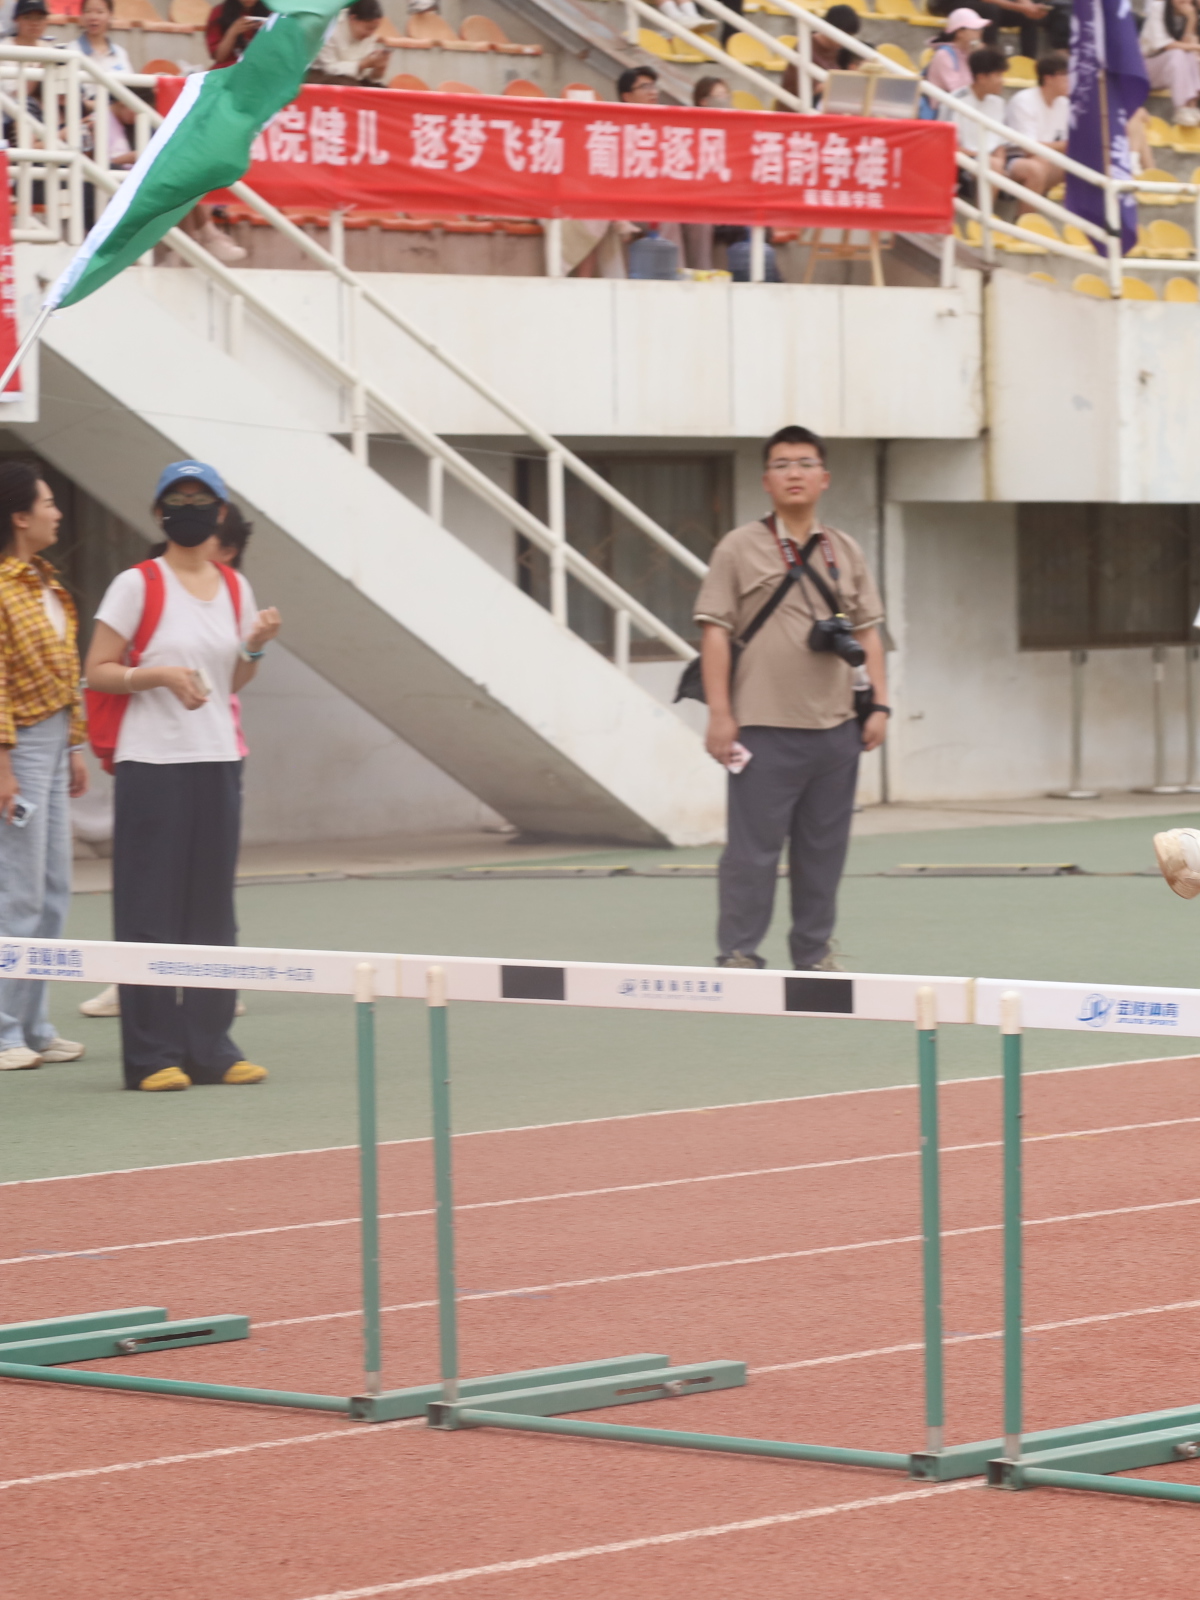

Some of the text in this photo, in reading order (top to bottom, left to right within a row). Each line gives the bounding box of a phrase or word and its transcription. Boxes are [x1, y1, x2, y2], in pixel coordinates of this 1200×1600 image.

[250, 104, 390, 166] 院健儿
[410, 113, 565, 175] 逐梦飞扬
[585, 121, 732, 183] 葡院逐风
